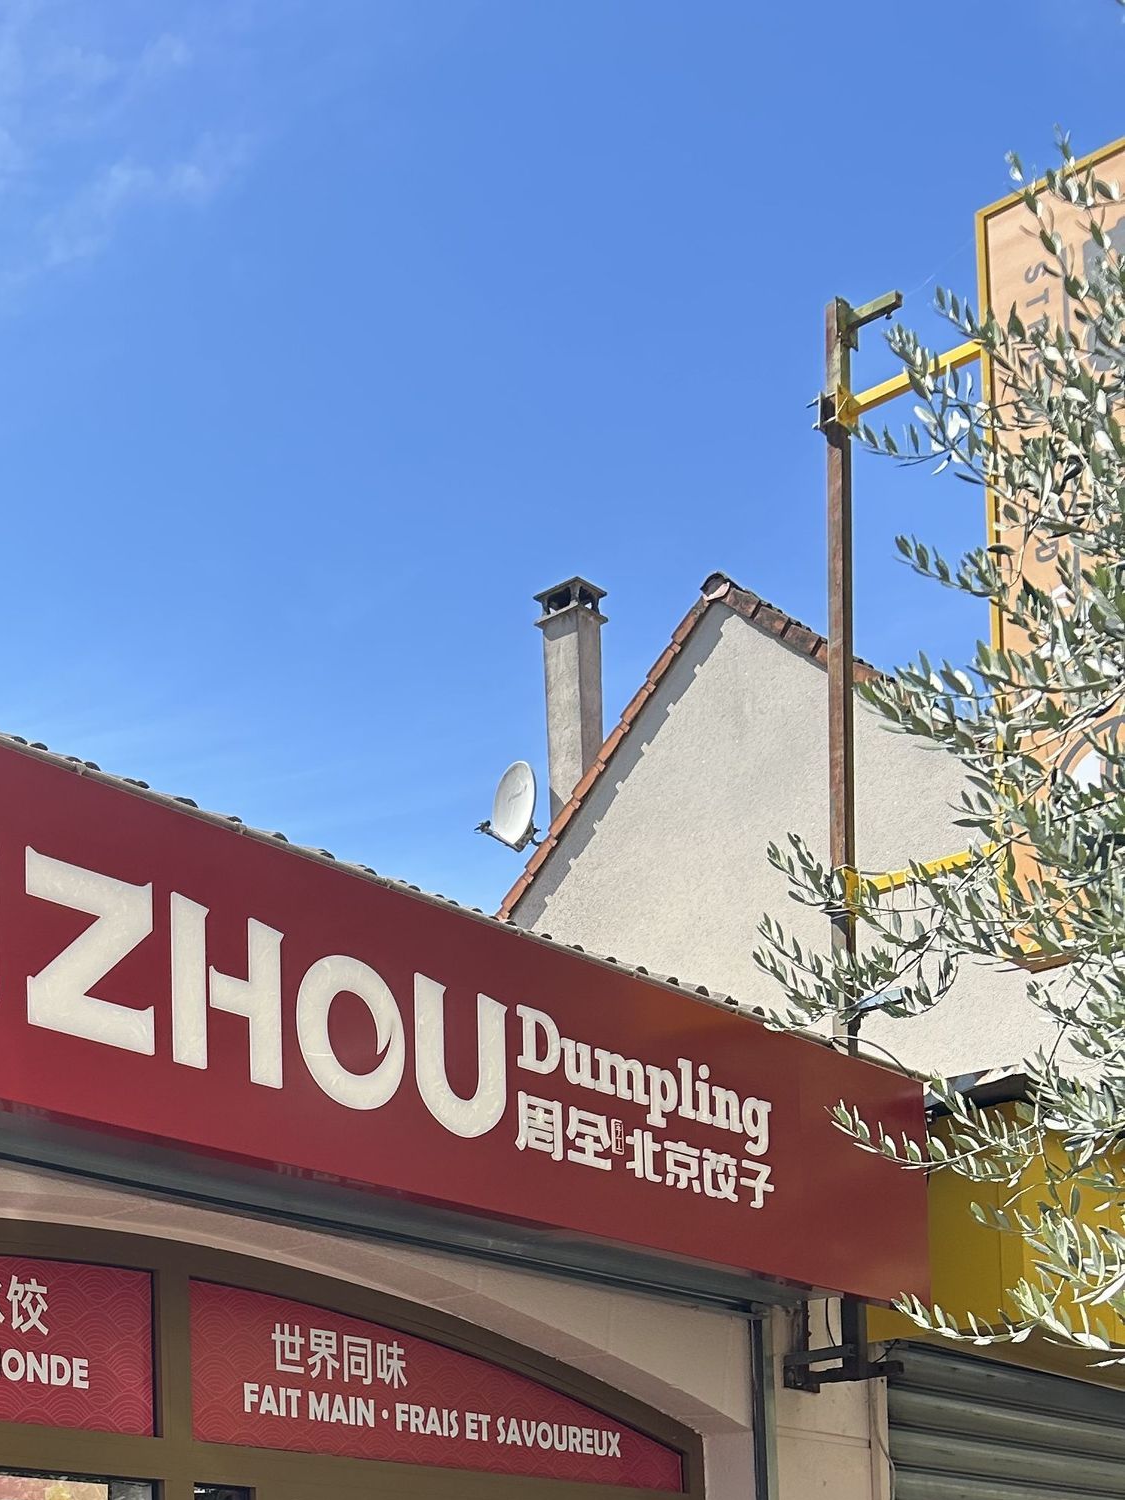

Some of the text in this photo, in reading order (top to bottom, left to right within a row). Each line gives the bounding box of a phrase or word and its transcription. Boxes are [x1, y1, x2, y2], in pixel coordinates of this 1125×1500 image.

[26, 846, 508, 1139] ZHOU
[516, 1004, 772, 1154] Dumpling
[625, 1128, 774, 1209] 北京饺子
[271, 1323, 408, 1389] 世界同味
[243, 1382, 622, 1458] FAIT MAIN FRAIS ET SAVOUREUX
